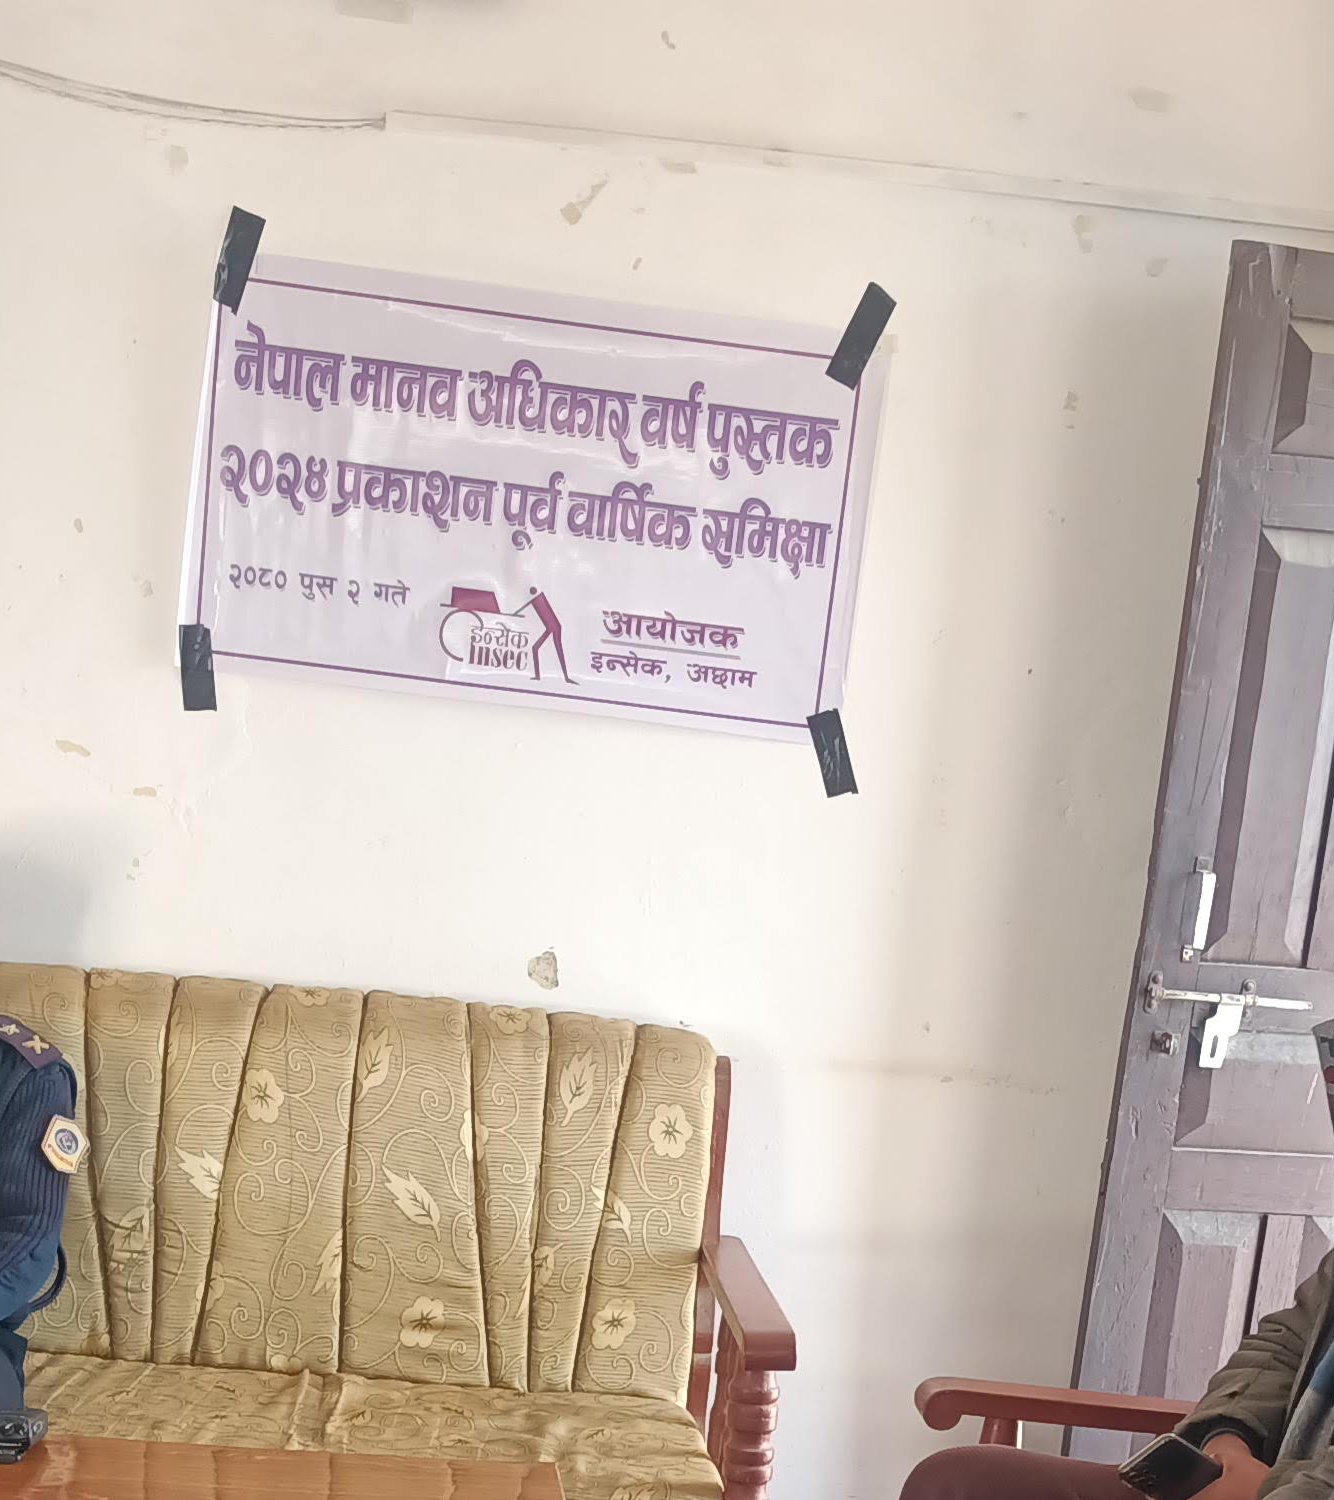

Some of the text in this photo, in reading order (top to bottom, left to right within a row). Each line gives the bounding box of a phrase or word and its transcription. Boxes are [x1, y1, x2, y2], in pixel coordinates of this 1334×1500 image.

[234, 320, 840, 479] नेपाल मानव अधिकार वर्ष पुस्तक
[220, 444, 832, 578] २०२४ प्रकाशन पूर्व वार्षिक समिक्षा
[229, 564, 410, 606] २०८० पुस २ गते
[602, 610, 744, 650] आयोजक
[590, 651, 757, 689] इन्सेक, अछाम
